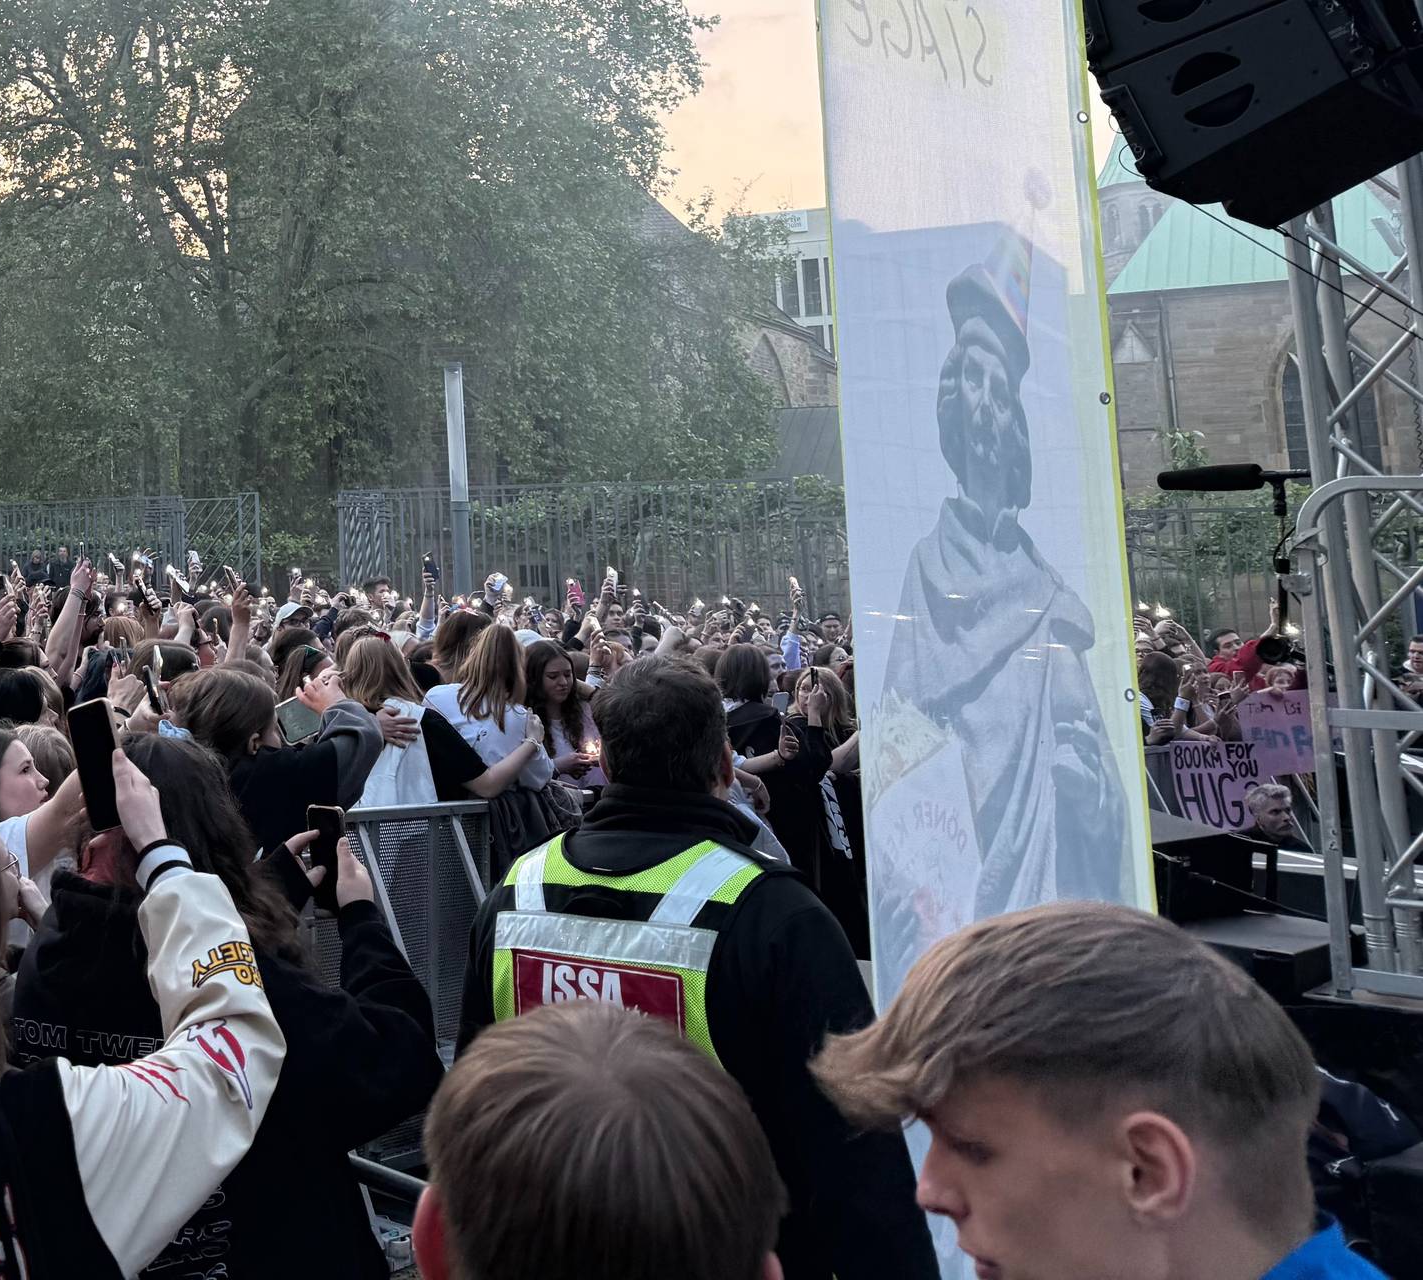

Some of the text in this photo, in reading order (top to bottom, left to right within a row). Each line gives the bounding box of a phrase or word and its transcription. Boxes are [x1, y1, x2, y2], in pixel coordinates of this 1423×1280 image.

[1227, 759, 1259, 779] YOU
[542, 962, 625, 1010] ISSA
[11, 1017, 67, 1050] TOM
